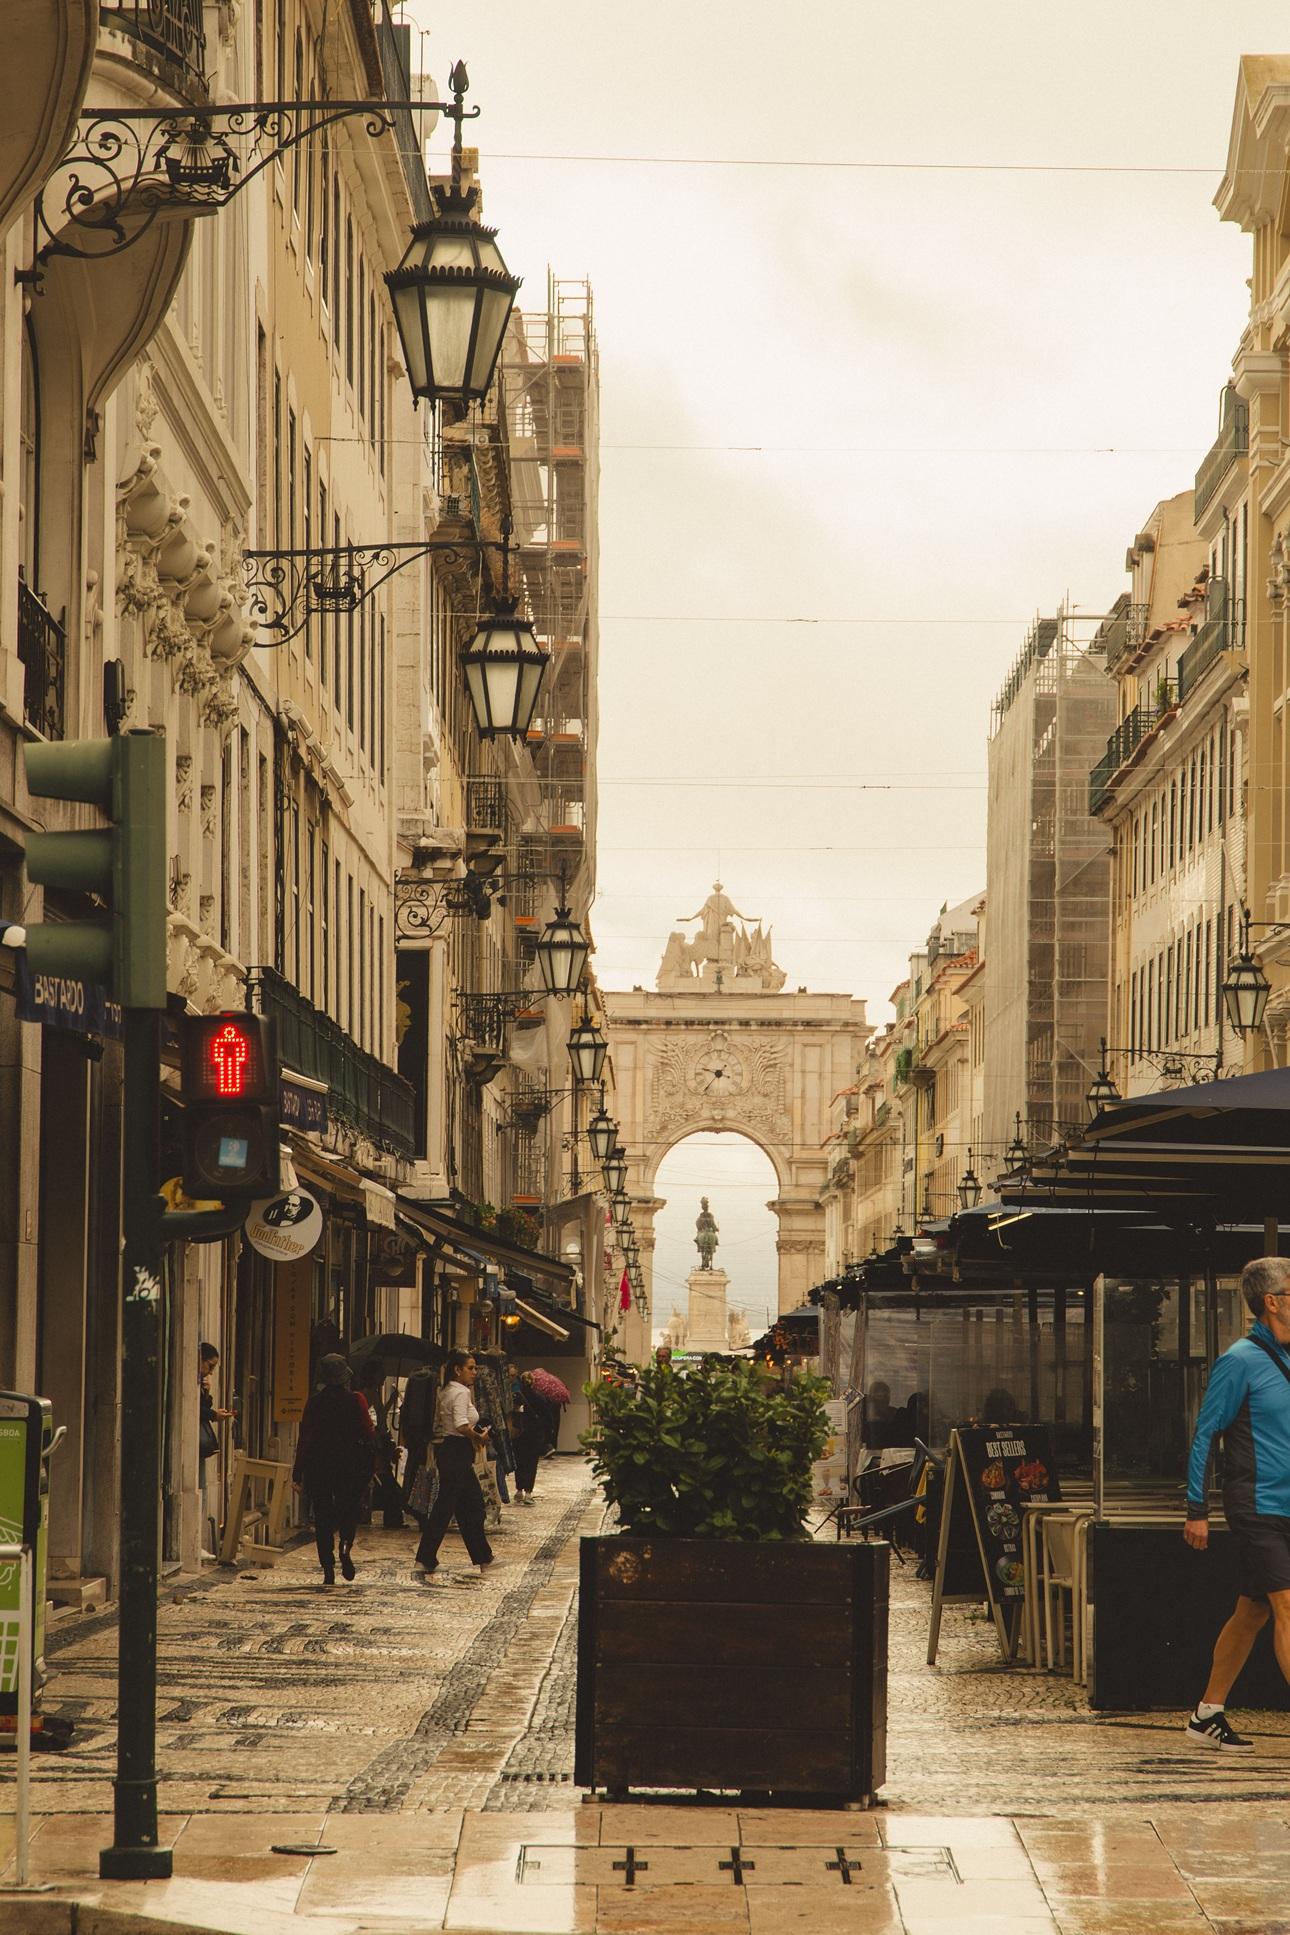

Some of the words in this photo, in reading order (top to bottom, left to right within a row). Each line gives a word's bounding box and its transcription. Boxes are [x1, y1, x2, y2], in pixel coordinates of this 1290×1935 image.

[34, 974, 85, 1015] BASTARDO
[249, 1224, 305, 1255] Godfather
[986, 1441, 1002, 1458] BEST
[1001, 1440, 1027, 1457] SELLERS
